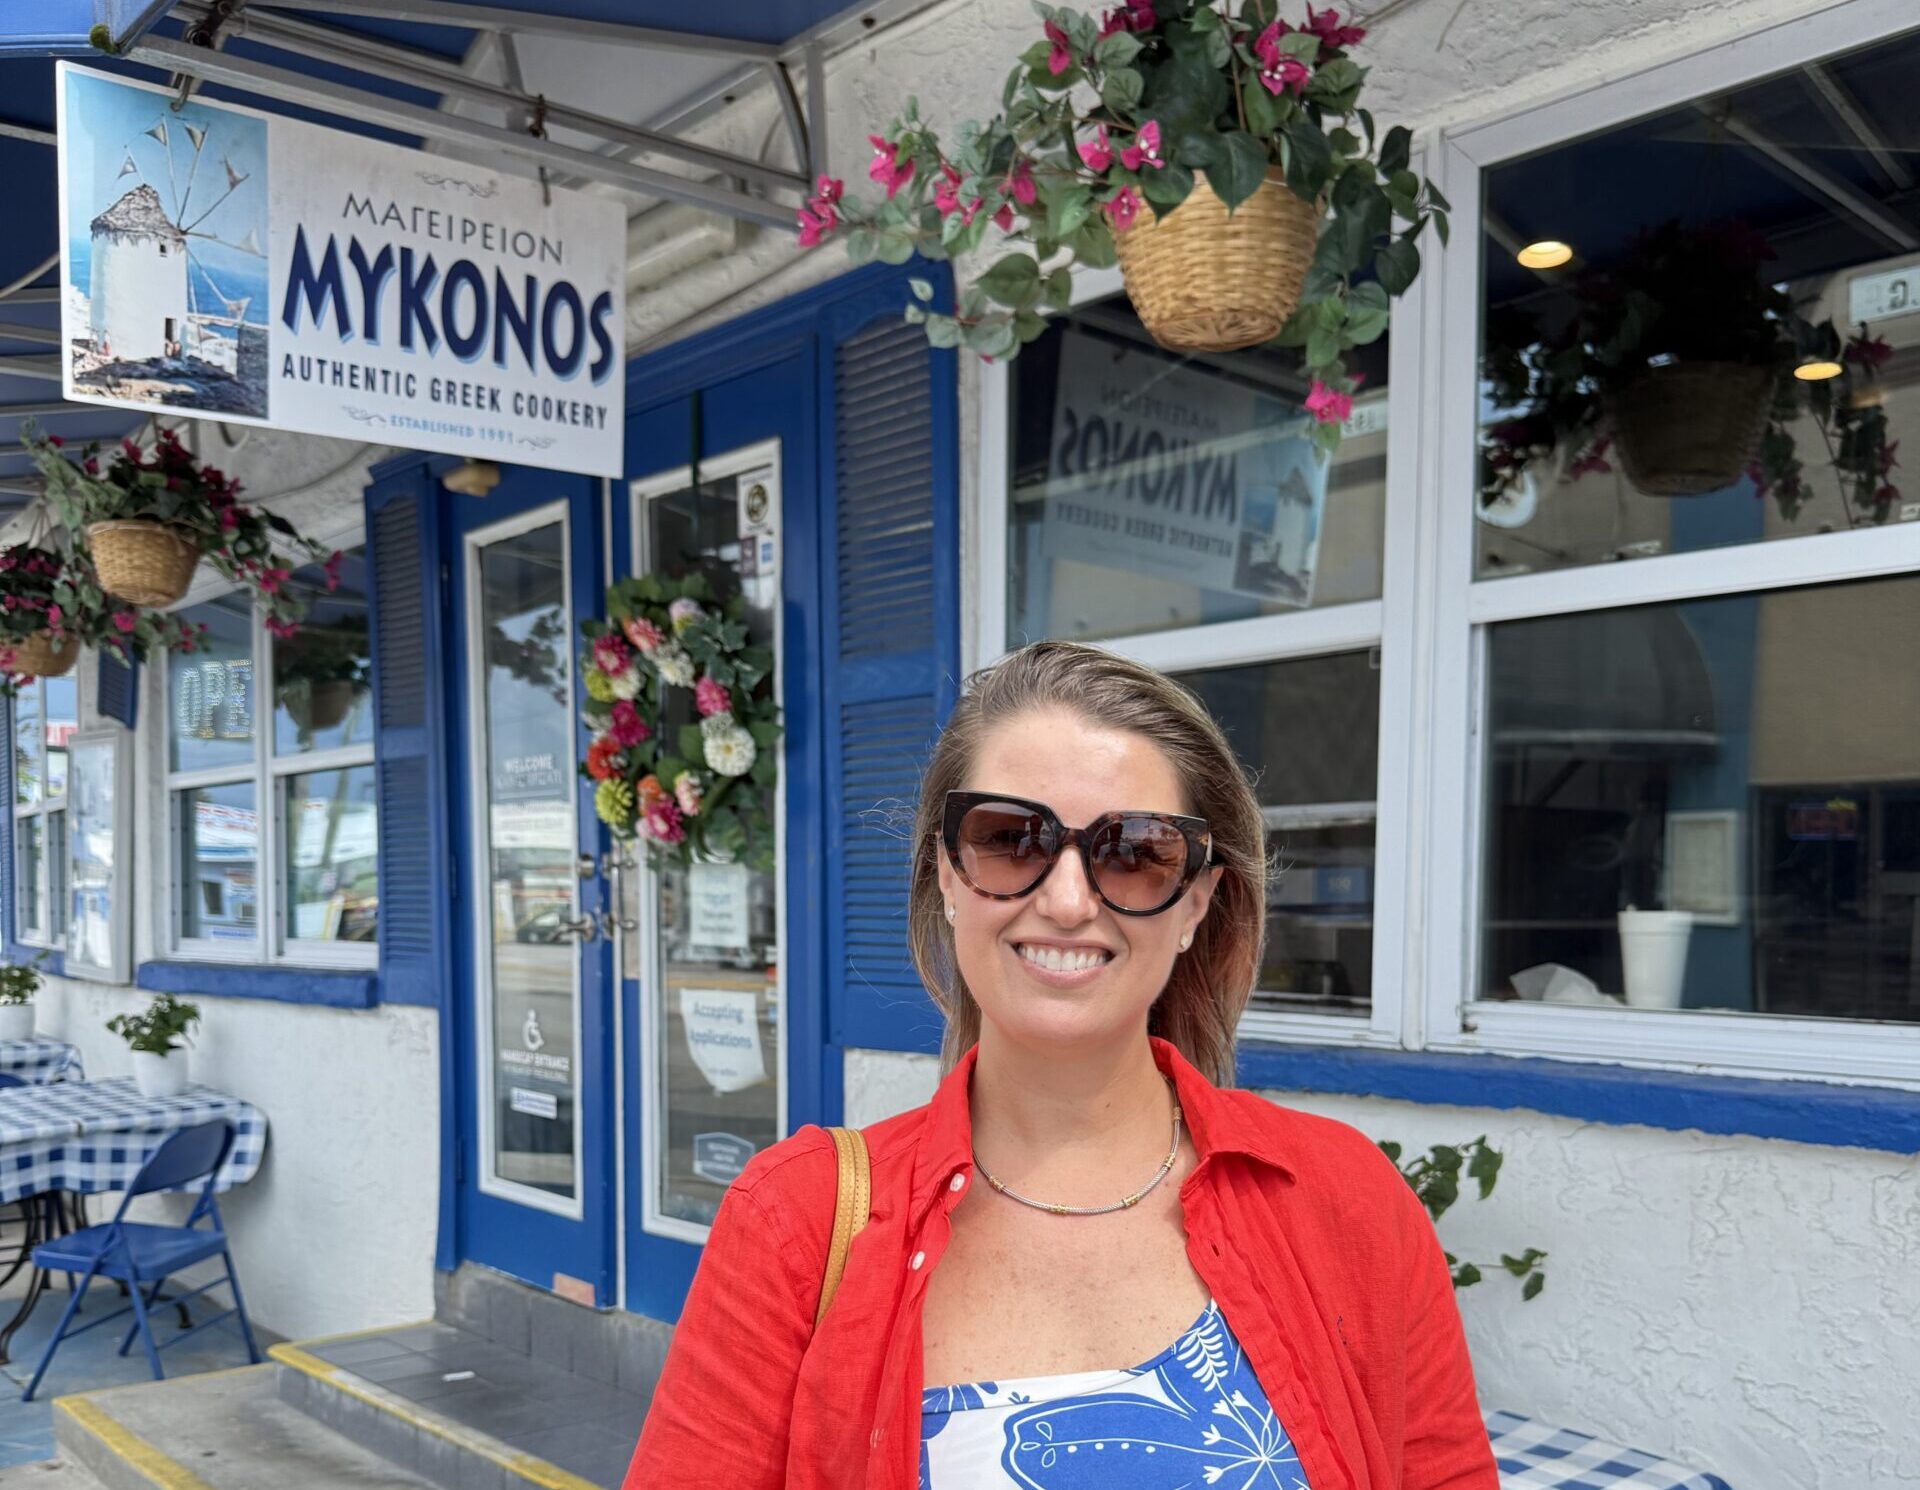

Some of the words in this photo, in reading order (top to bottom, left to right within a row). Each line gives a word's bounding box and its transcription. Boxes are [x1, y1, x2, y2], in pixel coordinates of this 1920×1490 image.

[342, 192, 564, 265] ΜΑΓΕΙΡΕΙΟΝ
[281, 222, 615, 388] MYKONOS
[282, 353, 417, 399] AUTHENTIC
[430, 378, 502, 413] GREEK
[513, 391, 608, 430] COOKERY
[389, 414, 475, 439] ESTABLISHED
[480, 424, 515, 444] 1991
[693, 1001, 744, 1024] Accepting
